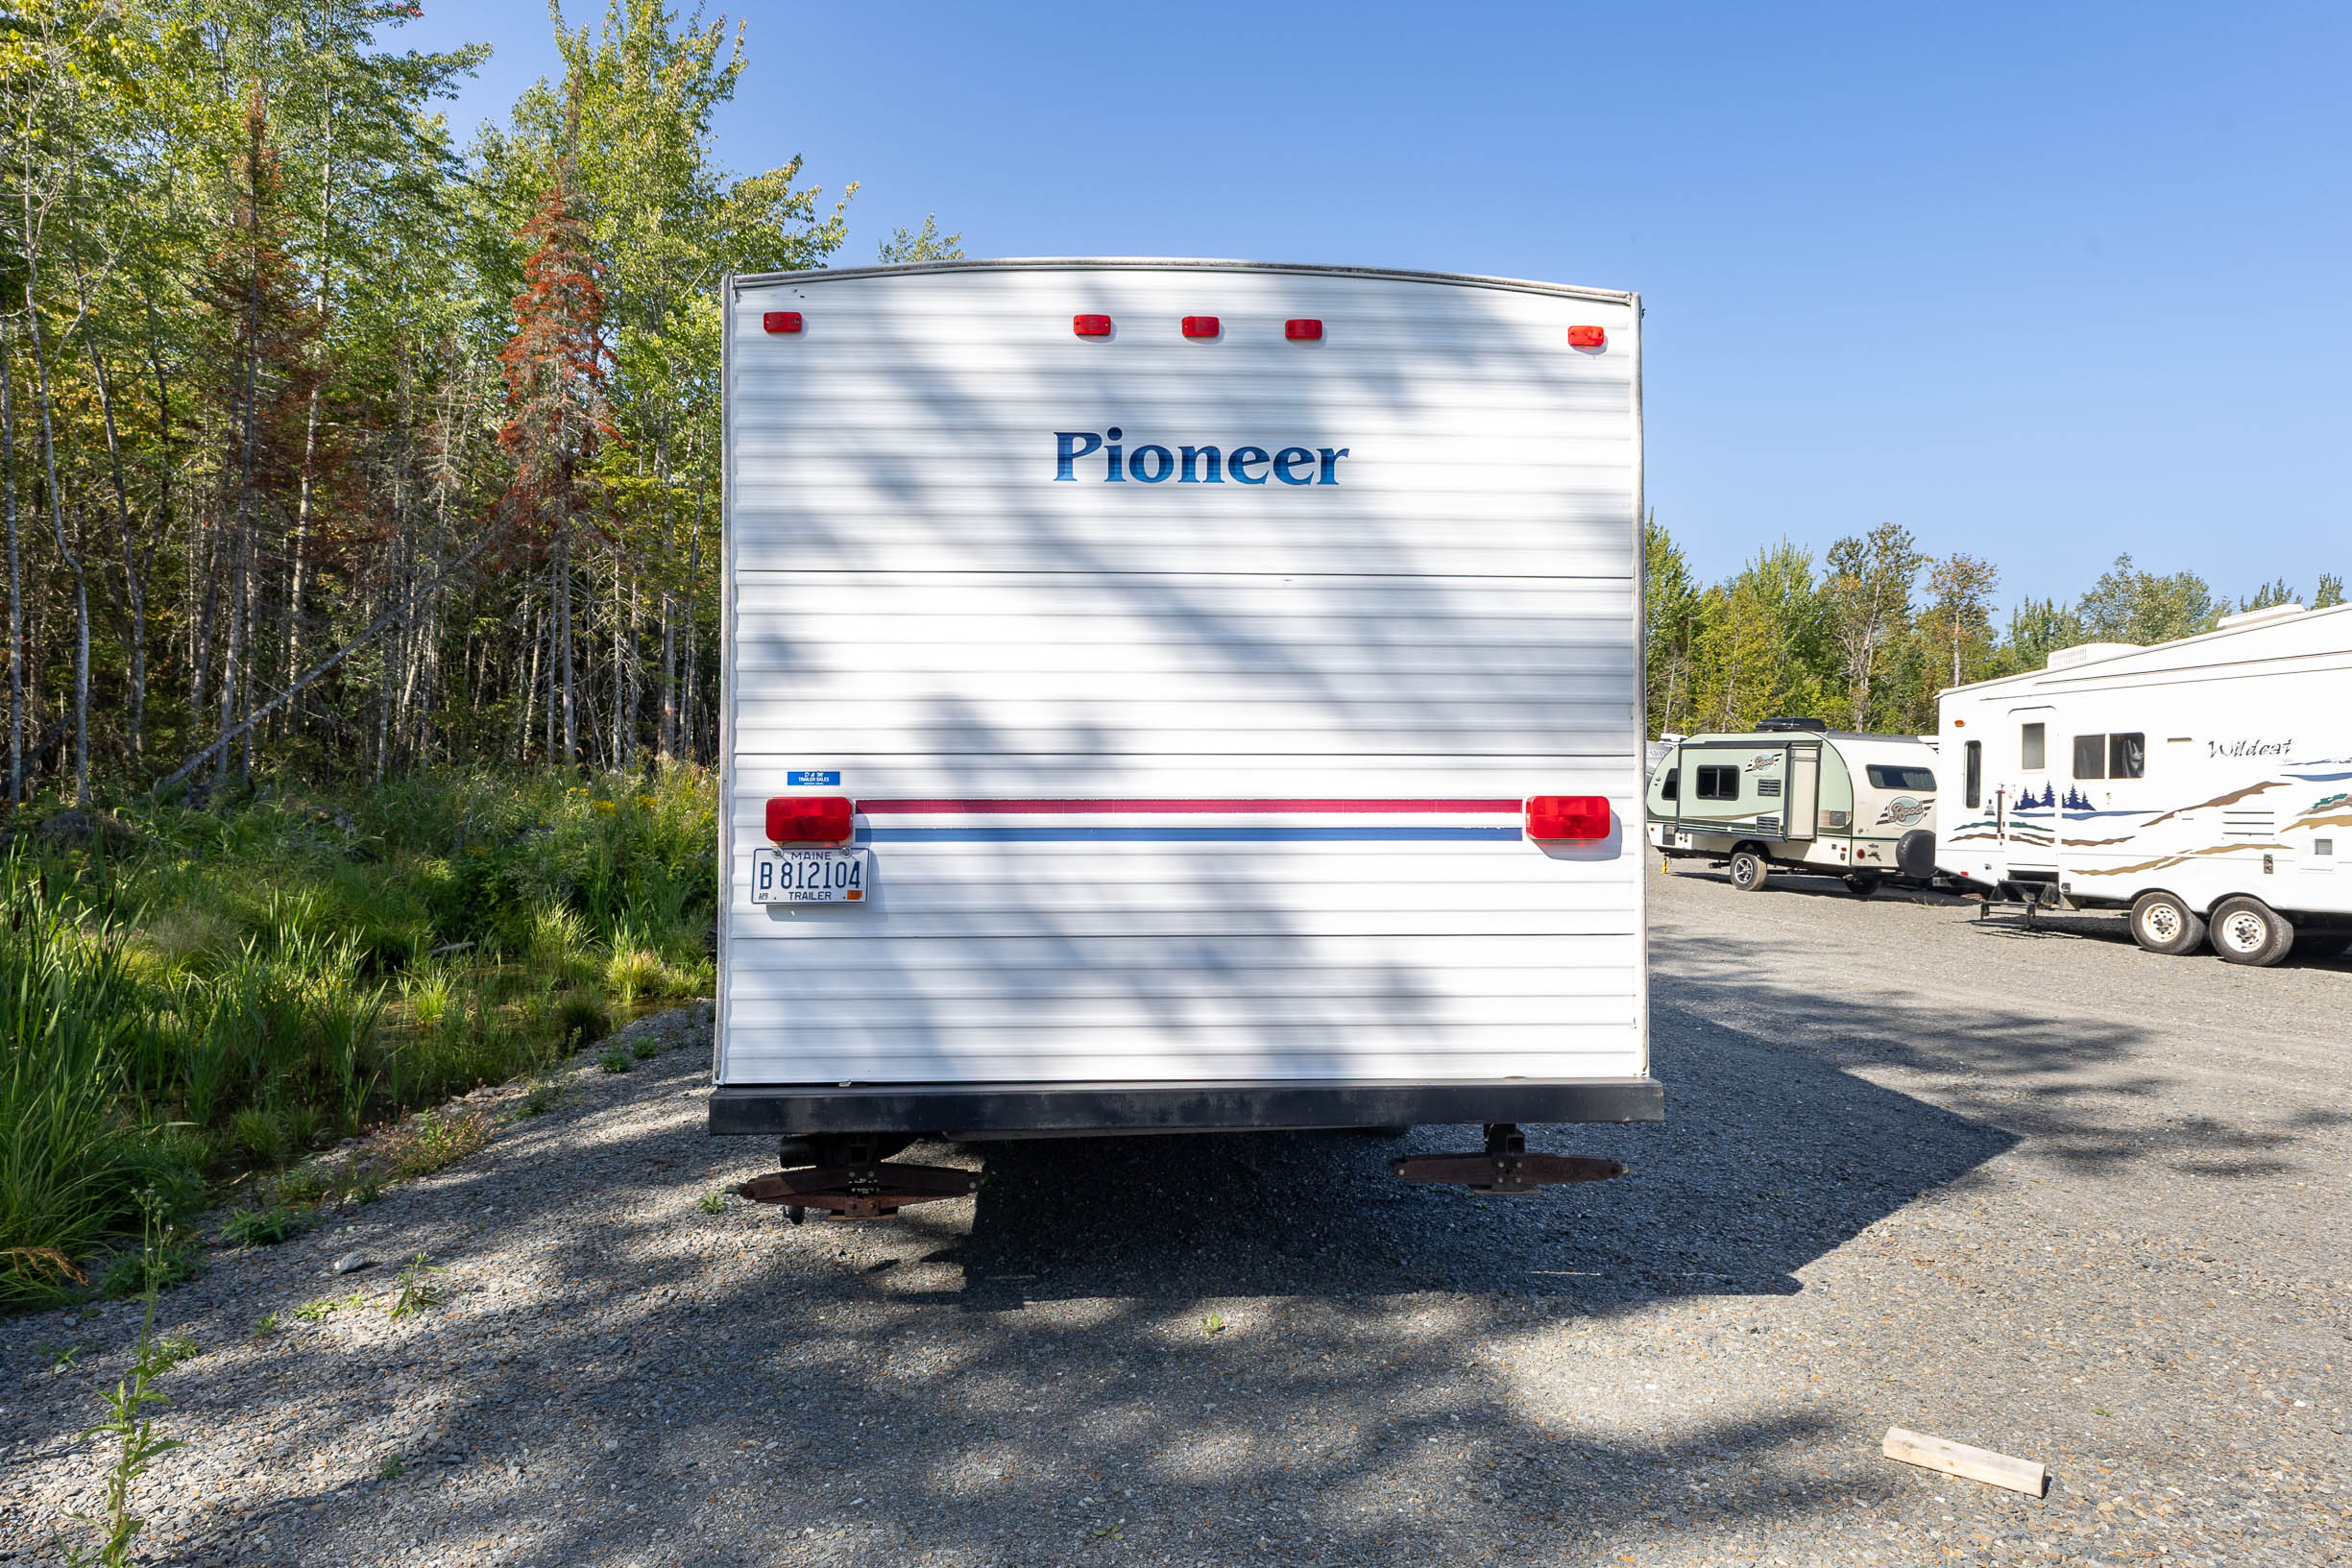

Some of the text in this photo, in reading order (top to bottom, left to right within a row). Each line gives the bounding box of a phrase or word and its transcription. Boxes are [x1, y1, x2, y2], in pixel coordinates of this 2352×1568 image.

[1053, 426, 1350, 486] Pioneer
[2208, 738, 2292, 759] Wildcat
[790, 852, 832, 860] MAINE
[760, 861, 861, 889] B 812104
[788, 891, 832, 901] TRAILER
